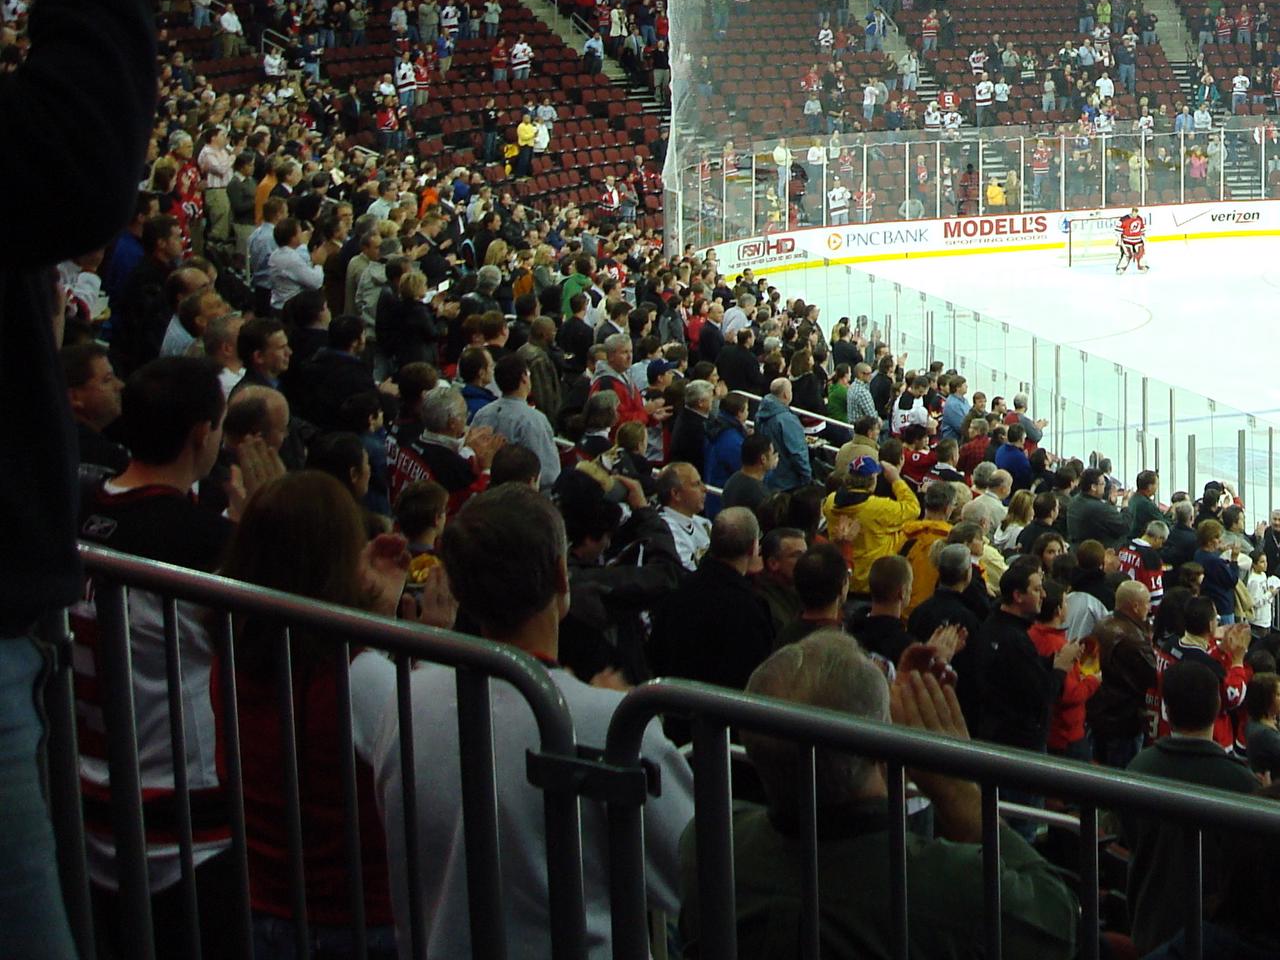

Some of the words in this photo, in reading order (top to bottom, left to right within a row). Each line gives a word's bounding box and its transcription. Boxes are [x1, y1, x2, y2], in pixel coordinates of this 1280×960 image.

[1211, 209, 1261, 224] verizon
[944, 216, 1047, 238] MODELL'S
[886, 229, 928, 245] BANK
[742, 242, 761, 258] FSN
[767, 238, 795, 255] HD
[1150, 574, 1163, 590] 14
